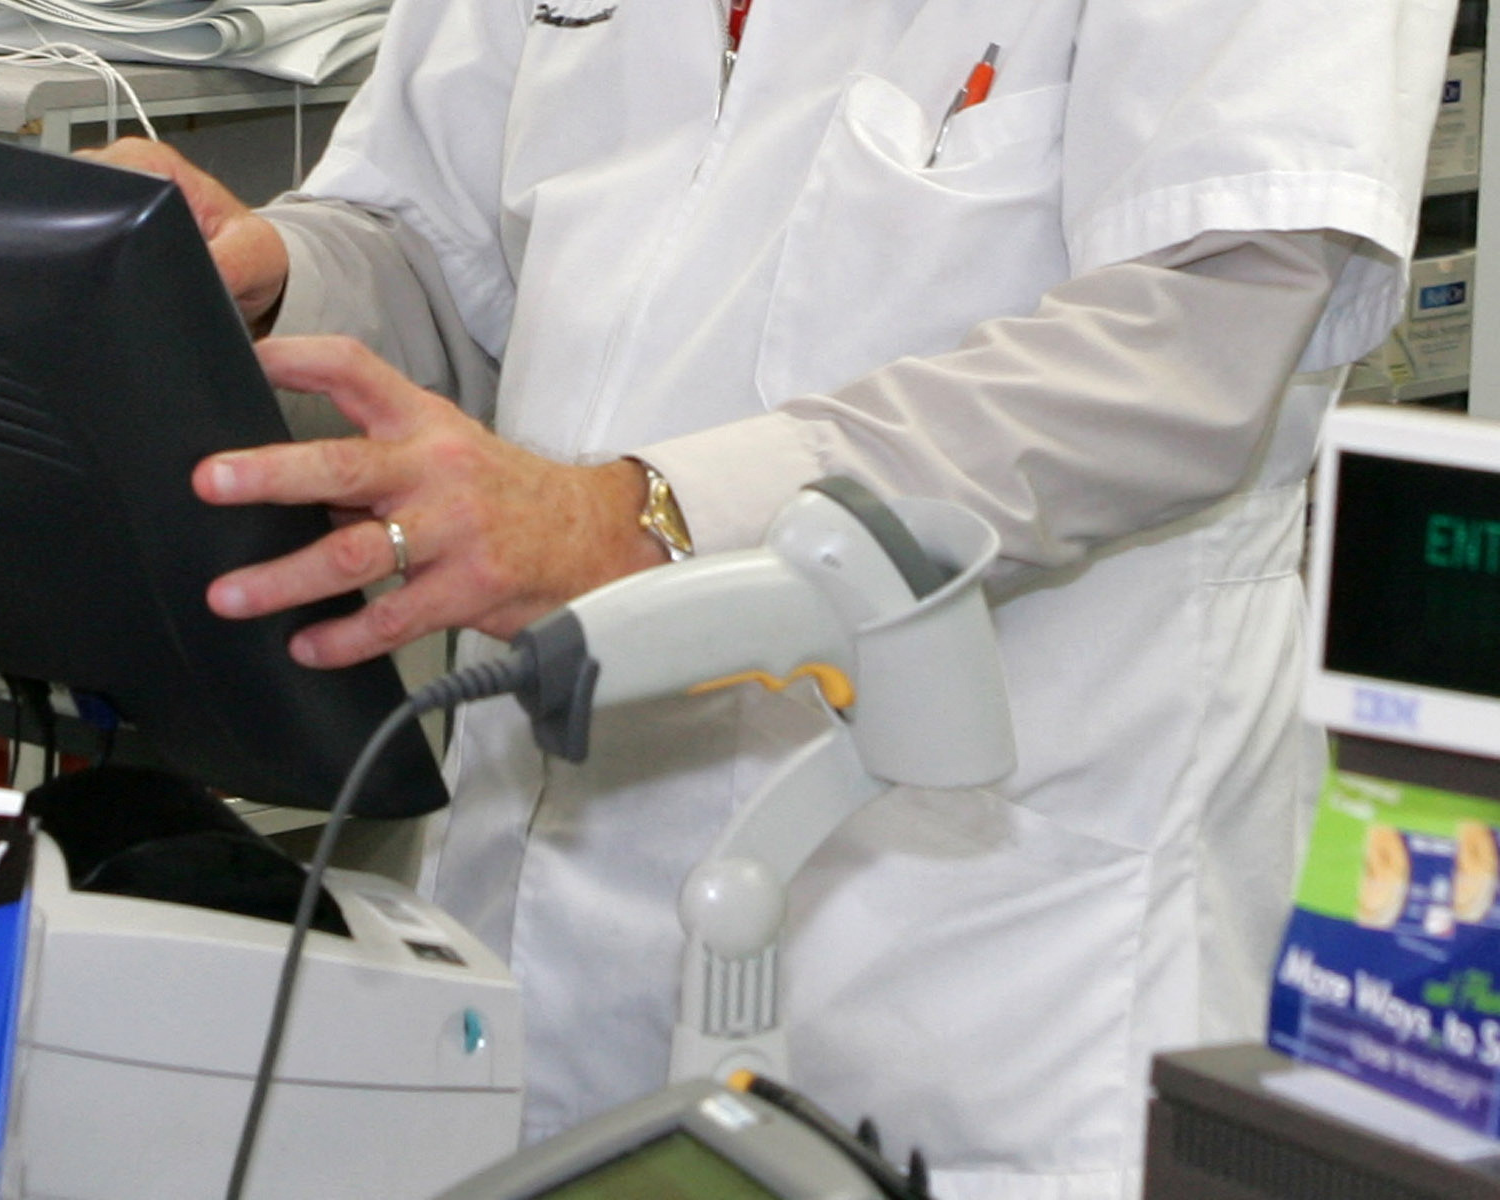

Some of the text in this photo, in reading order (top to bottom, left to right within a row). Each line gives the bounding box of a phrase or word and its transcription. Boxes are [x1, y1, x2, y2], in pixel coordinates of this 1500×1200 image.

[1353, 686, 1422, 733] IBM
[1278, 943, 1352, 1009] More
[1354, 967, 1433, 1046] Ways
[1442, 1008, 1476, 1059] to
